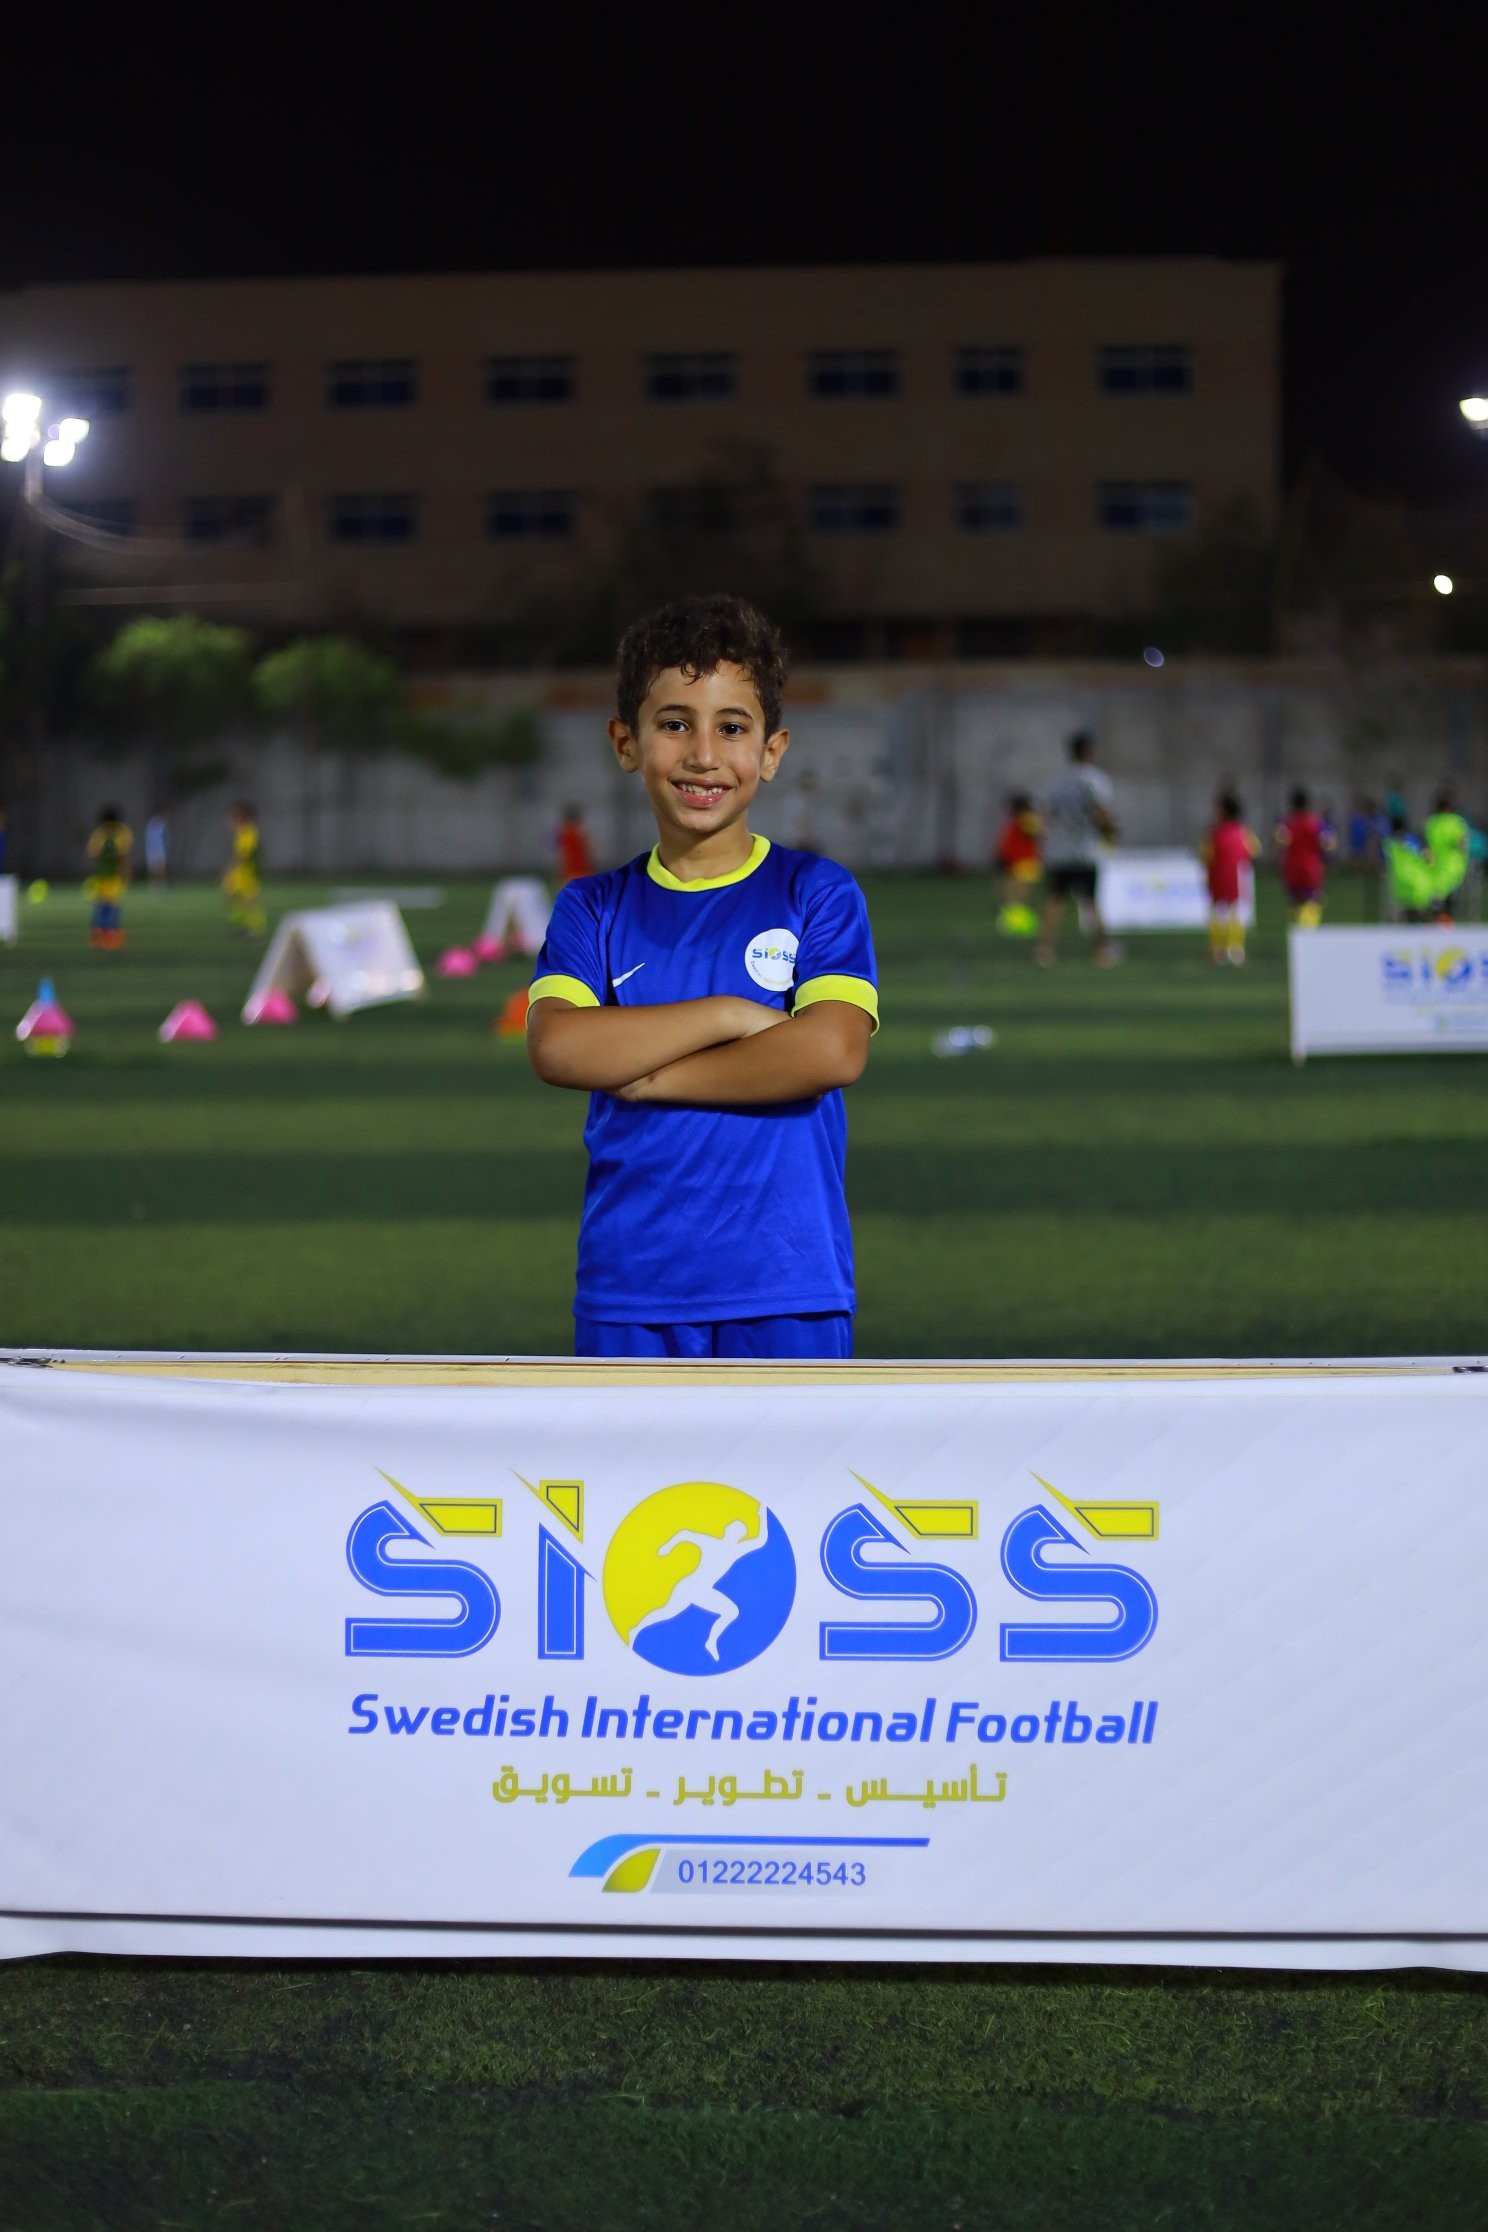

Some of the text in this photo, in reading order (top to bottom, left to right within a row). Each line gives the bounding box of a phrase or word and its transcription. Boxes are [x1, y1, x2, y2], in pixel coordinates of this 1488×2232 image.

[345, 1468, 1160, 1677] SIOSS
[348, 1693, 1159, 1746] Swedish International Football
[492, 1764, 633, 1804] تسويق
[673, 1768, 804, 1807] تطوير
[845, 1763, 1008, 1808] تأسيس
[677, 1859, 867, 1887] 01222224543
